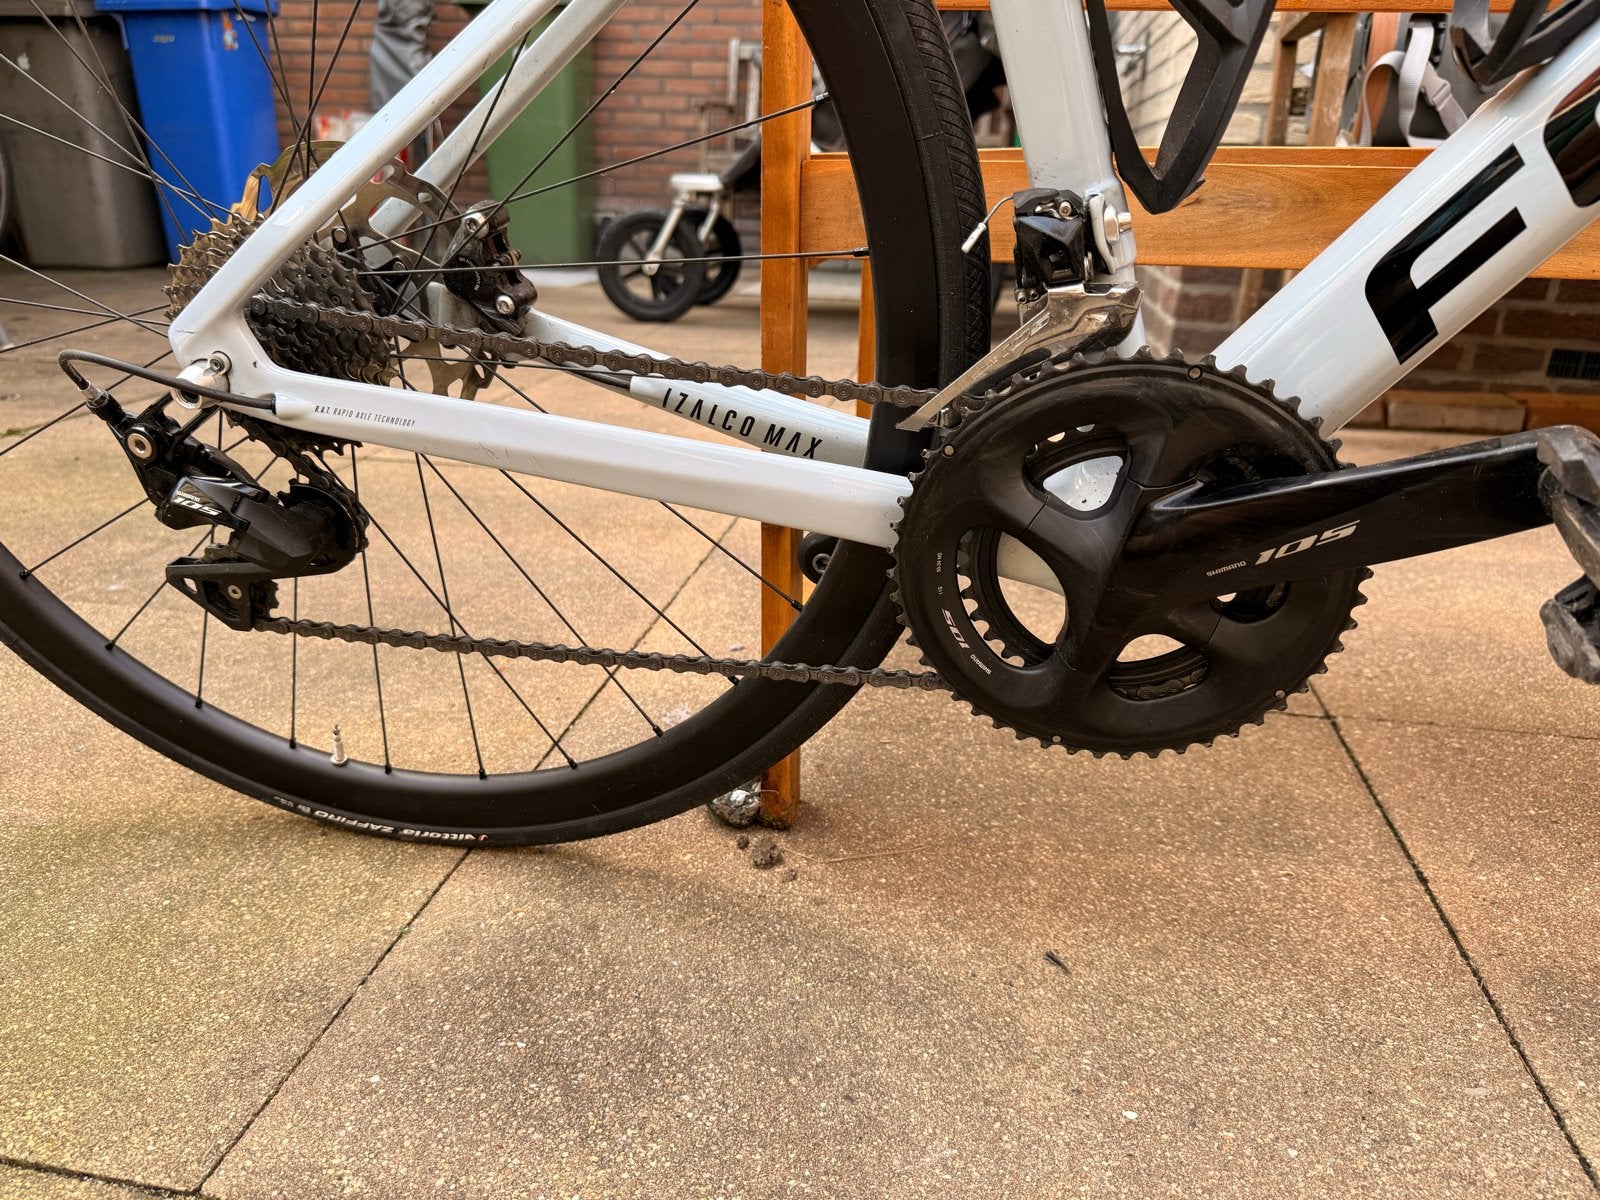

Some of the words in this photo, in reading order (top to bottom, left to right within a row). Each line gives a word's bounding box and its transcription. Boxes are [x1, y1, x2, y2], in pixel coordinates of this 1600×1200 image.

[333, 407, 354, 418] RAPID
[355, 411, 372, 421] AXLE
[374, 413, 416, 427] TECHNOLOGY
[662, 387, 756, 437] IZALCO
[763, 423, 823, 460] MAX
[173, 495, 223, 516] 105
[1206, 560, 1247, 577] SHIMANO
[1255, 519, 1361, 566] 105
[941, 608, 971, 649] 105
[970, 653, 992, 675] SHIMANO
[314, 809, 395, 834] ZAFFIRO
